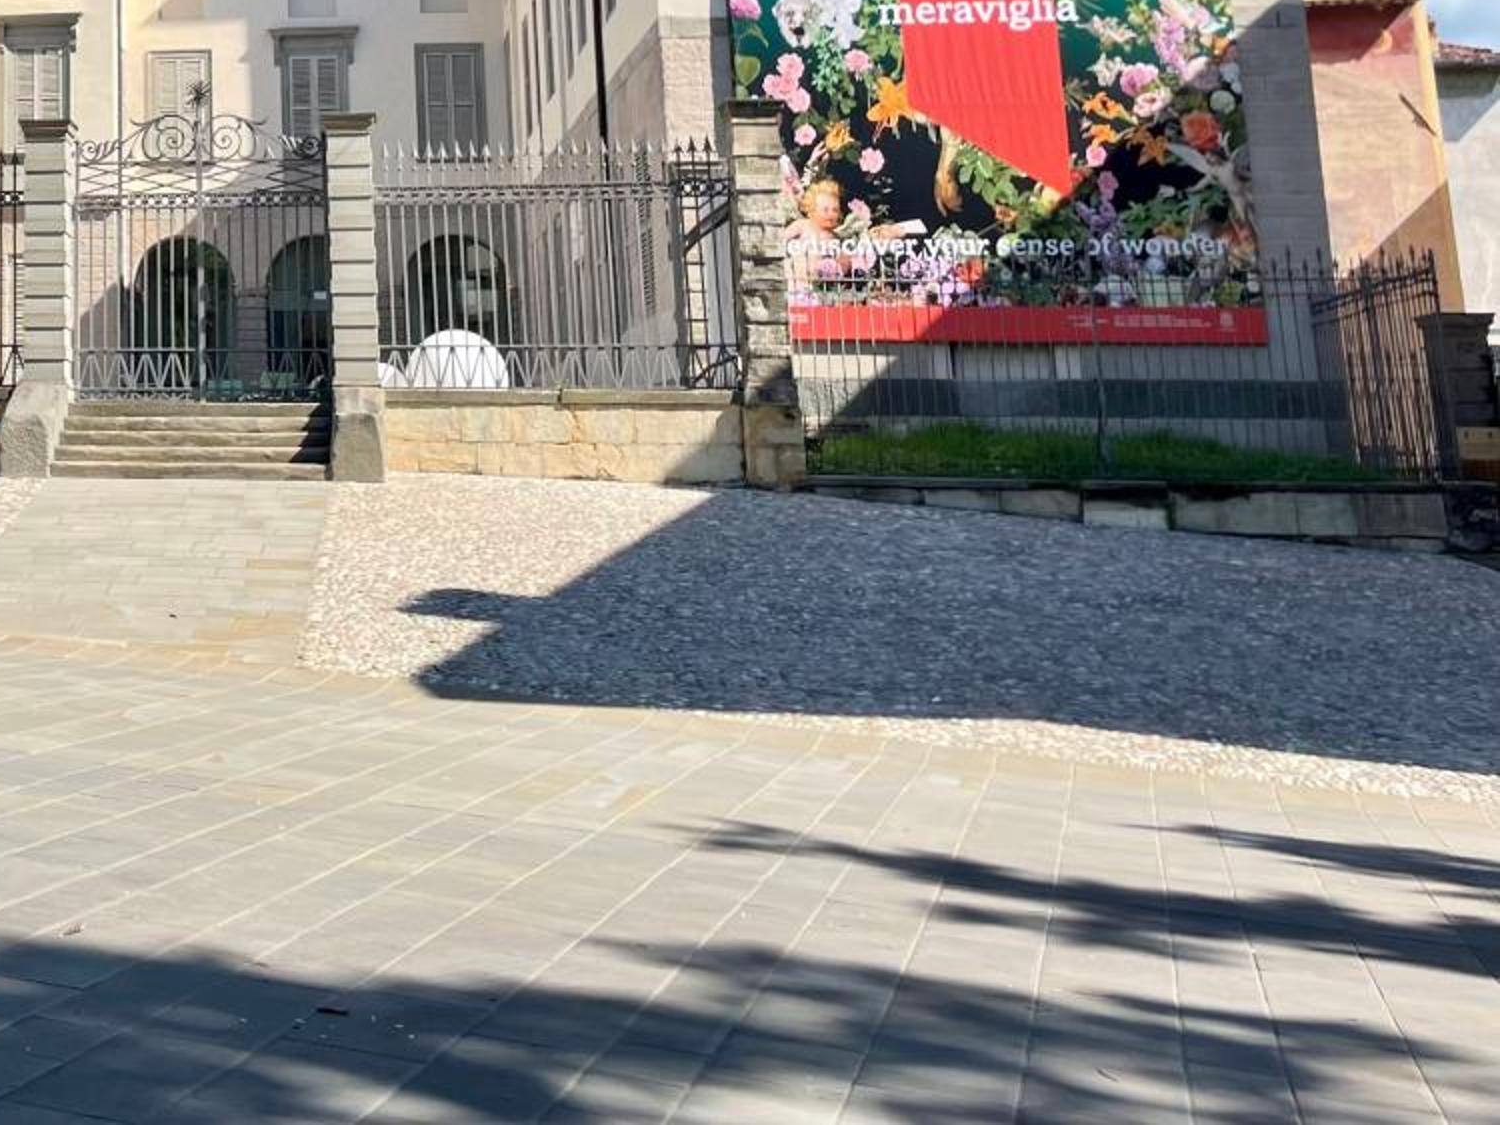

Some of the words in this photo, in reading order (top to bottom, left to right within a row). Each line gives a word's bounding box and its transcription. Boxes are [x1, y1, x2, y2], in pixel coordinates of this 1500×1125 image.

[923, 237, 990, 262] your
[996, 236, 1074, 256] sense
[1121, 233, 1228, 256] wonder
